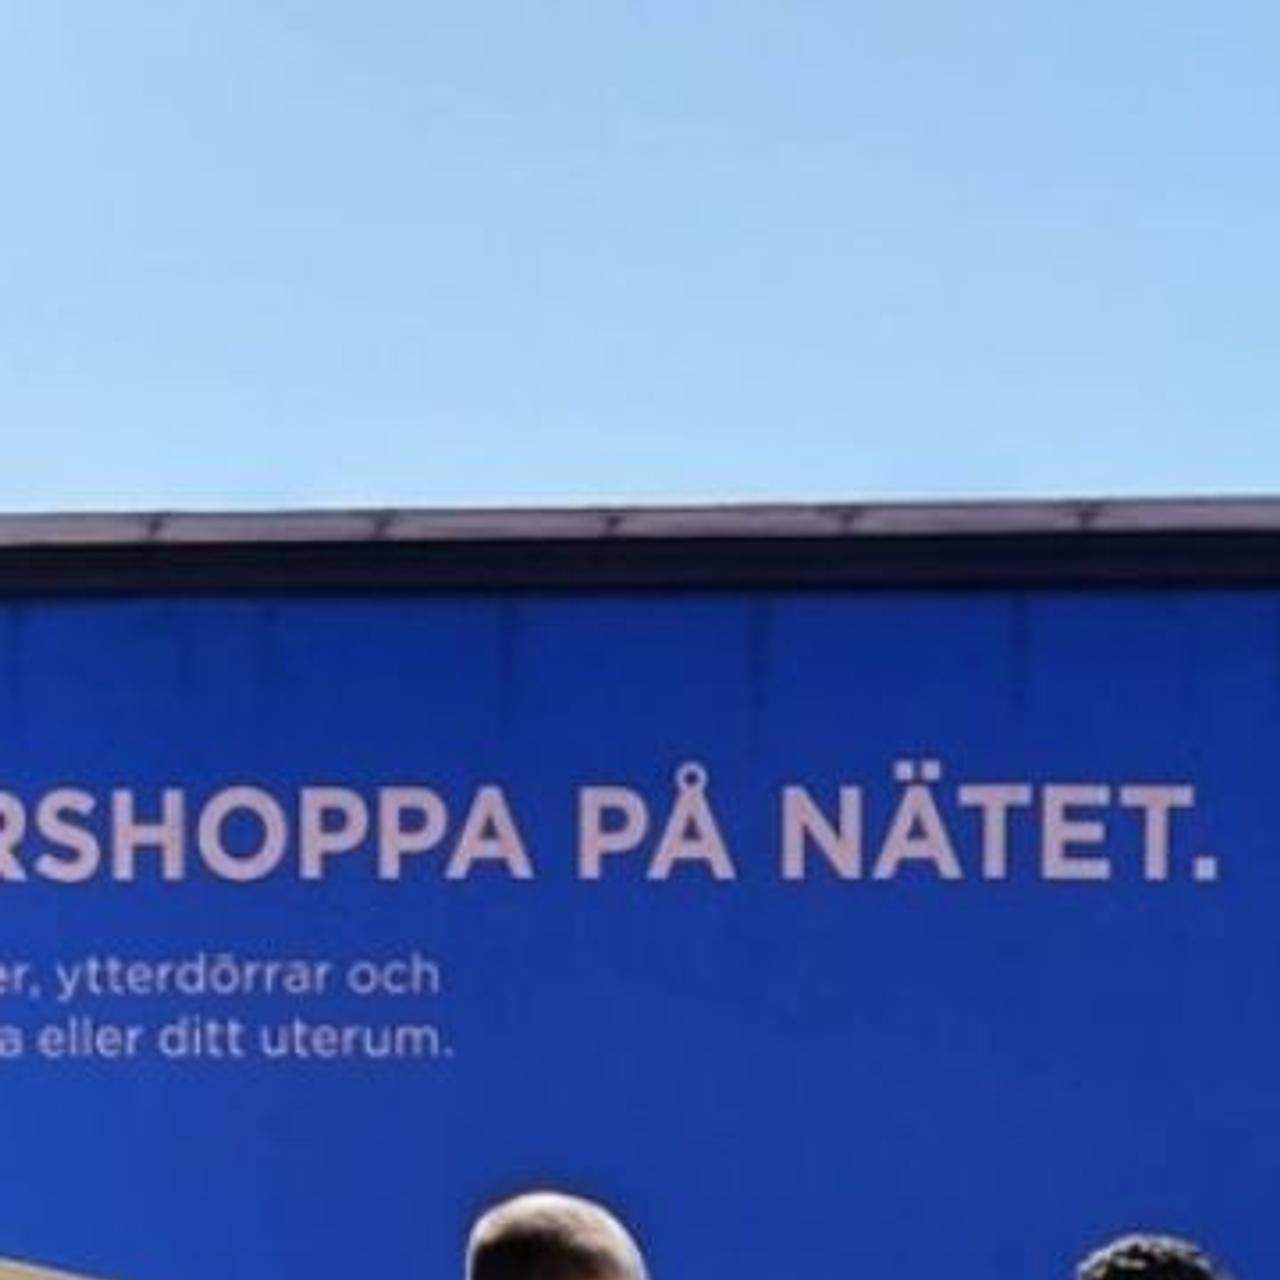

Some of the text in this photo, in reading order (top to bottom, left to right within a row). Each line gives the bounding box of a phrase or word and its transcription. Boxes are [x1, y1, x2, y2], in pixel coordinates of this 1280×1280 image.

[578, 761, 736, 881] PÅ
[781, 759, 1218, 881] NÄTET.
[55, 951, 331, 1003] ytterdörrar
[347, 952, 440, 996] och
[36, 1014, 144, 1060] eller
[157, 1015, 246, 1059] ditt
[260, 1017, 456, 1060] uterum.
